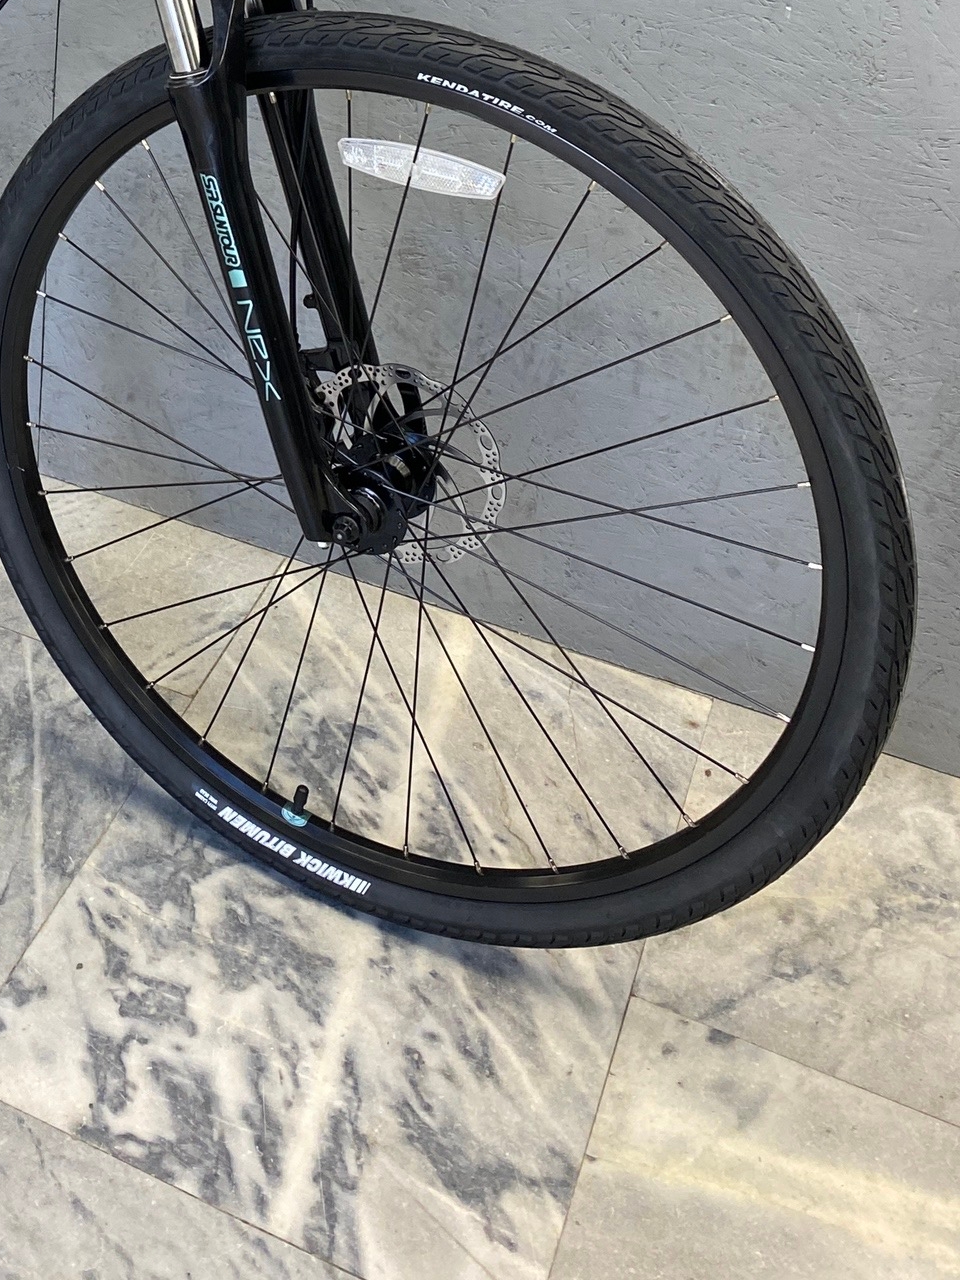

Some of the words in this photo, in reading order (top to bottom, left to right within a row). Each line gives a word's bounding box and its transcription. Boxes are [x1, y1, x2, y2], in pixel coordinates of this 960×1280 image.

[416, 72, 558, 134] KENDATIRE.COM
[217, 805, 297, 859] BITUMEN
[293, 850, 359, 890] KWICK
